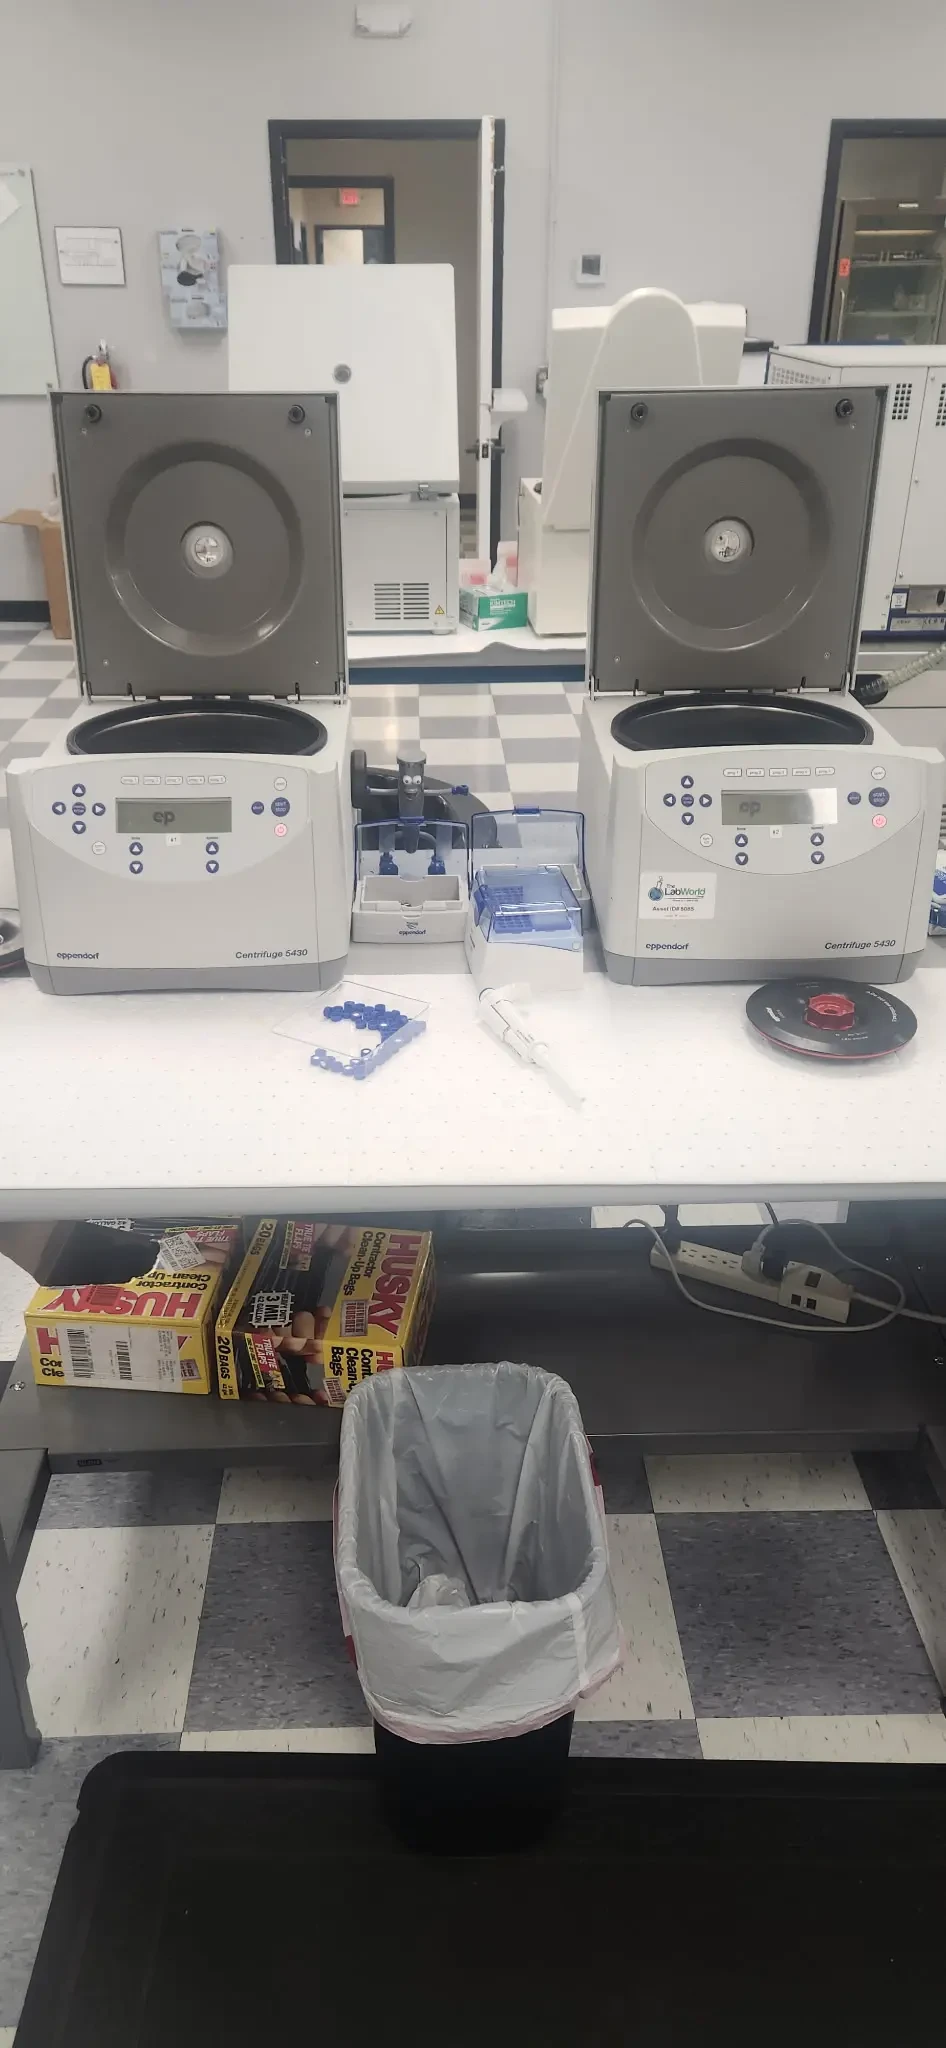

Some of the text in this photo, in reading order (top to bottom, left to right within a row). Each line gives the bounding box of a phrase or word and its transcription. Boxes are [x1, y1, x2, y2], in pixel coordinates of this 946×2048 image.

[152, 811, 175, 826] ep
[665, 888, 706, 896] LabWorld
[645, 942, 689, 950] eppendorf
[825, 939, 896, 950] Centrifuge 5430
[57, 952, 99, 960] eppendorf
[235, 948, 308, 959] Centrifuge 5430
[260, 1223, 273, 1238] 20
[363, 1231, 385, 1278] Contractor
[135, 1281, 208, 1291] Contractor
[344, 1273, 360, 1296] Bags
[368, 1234, 422, 1336] HUSKY
[264, 1304, 279, 1322] MIL
[217, 1336, 231, 1379] 20 BAGS
[255, 1344, 267, 1365] FLAPS
[263, 1339, 278, 1369] TRUE TIE
[329, 1346, 344, 1376] Bags
